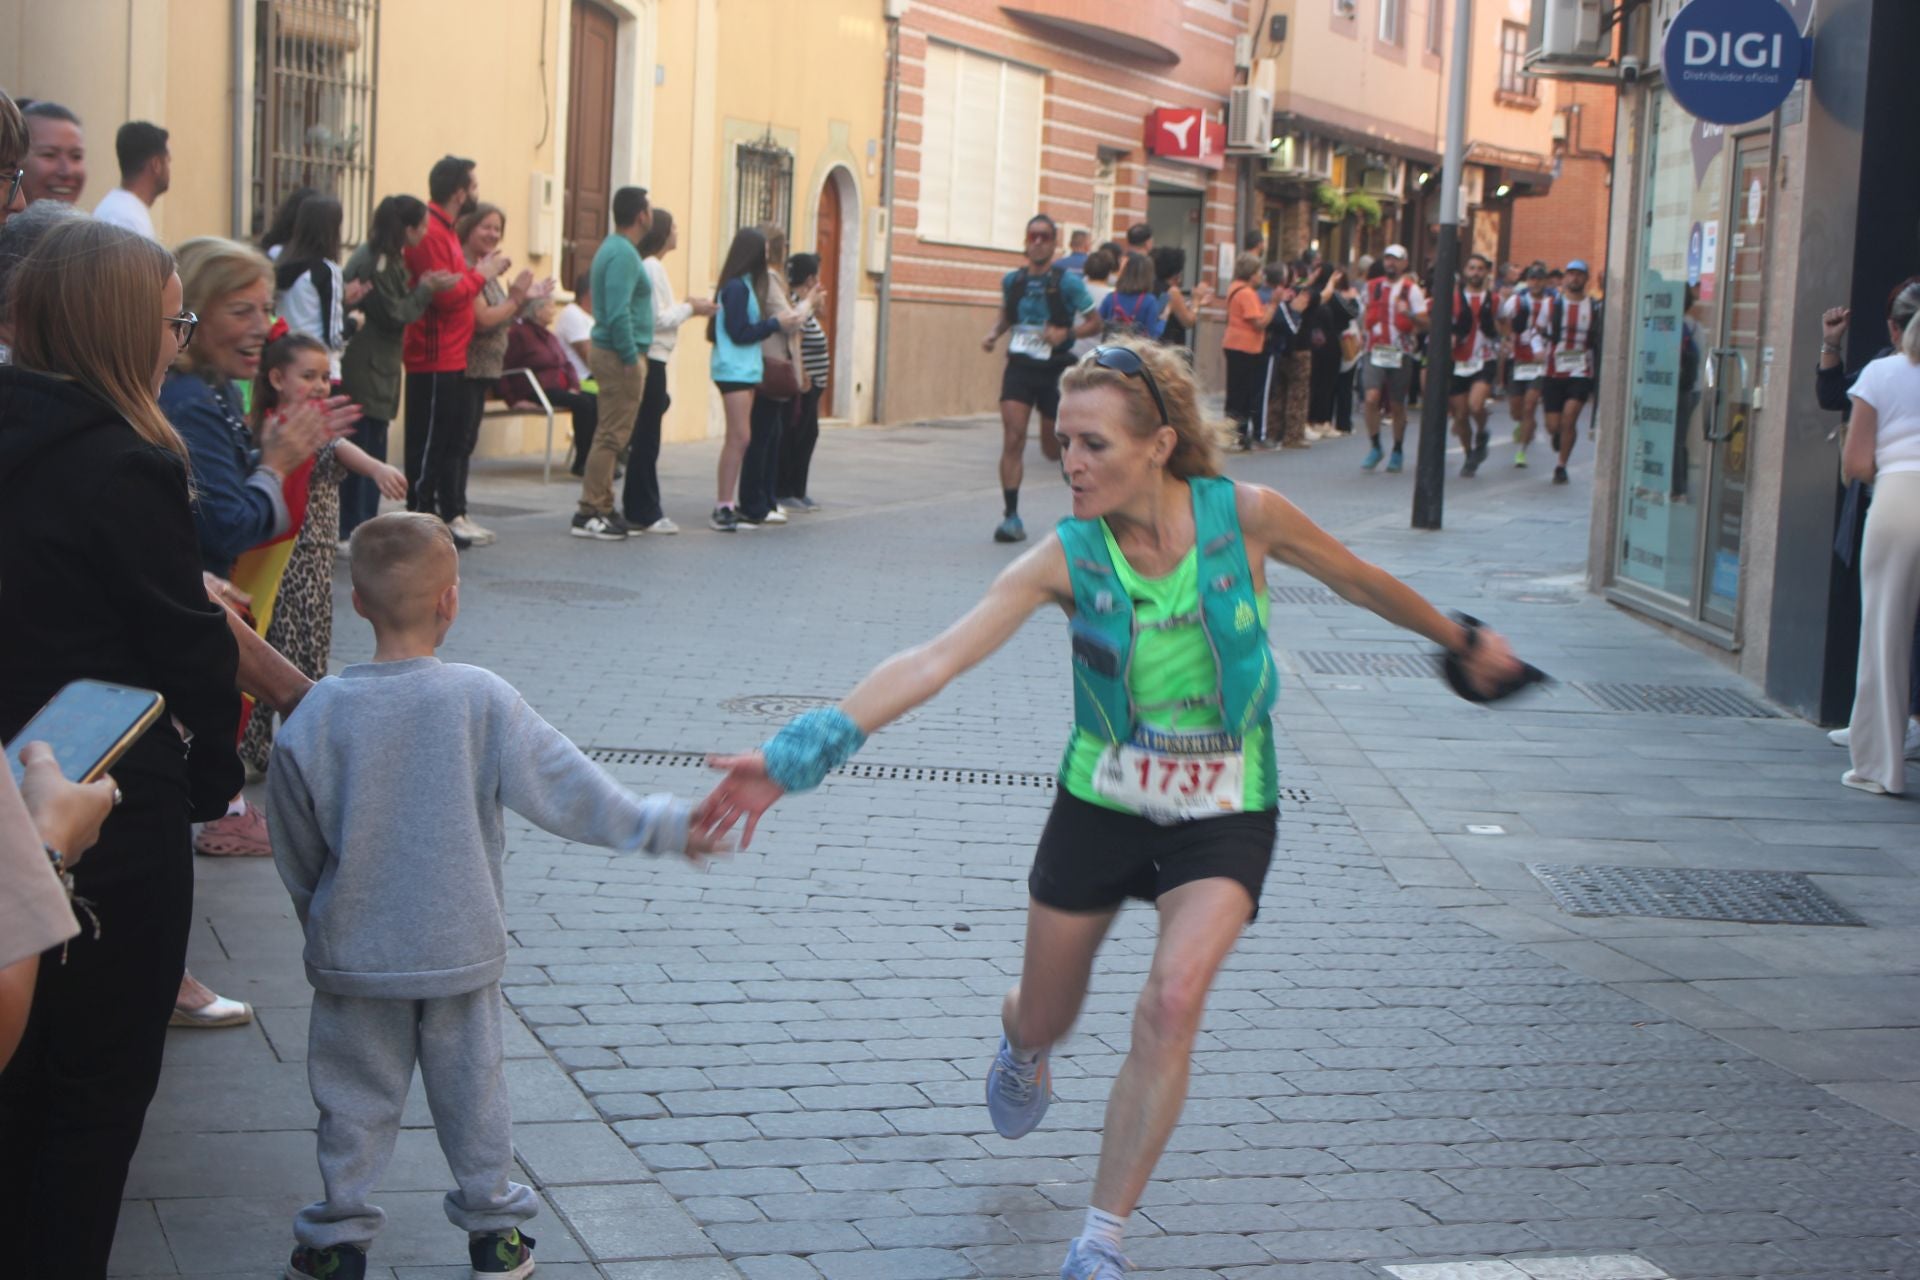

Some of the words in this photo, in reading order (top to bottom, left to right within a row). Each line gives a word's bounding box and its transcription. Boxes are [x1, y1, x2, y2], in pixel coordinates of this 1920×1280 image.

[1684, 30, 1782, 68] DIGI
[1683, 70, 1744, 82] Distribuidor
[1745, 73, 1779, 83] oficial
[1134, 755, 1226, 797] 1737
